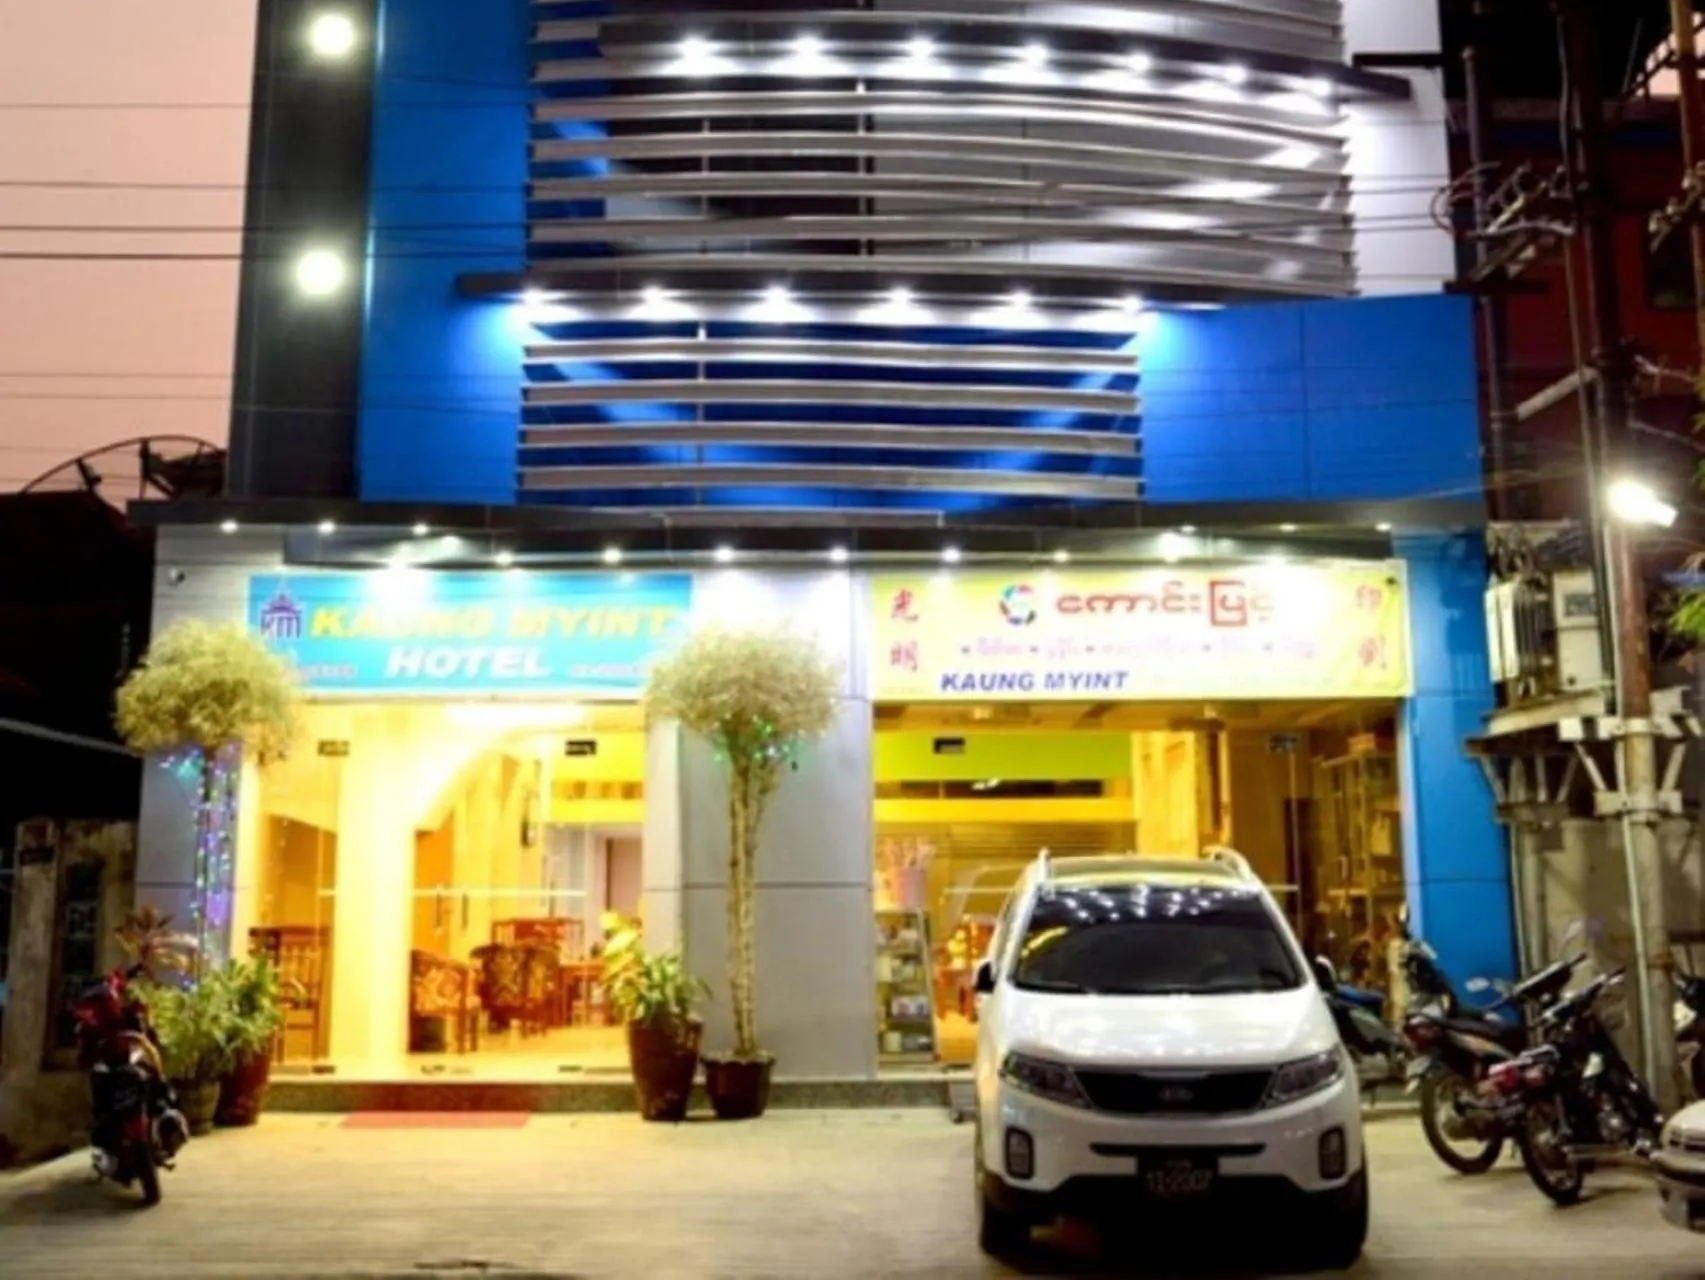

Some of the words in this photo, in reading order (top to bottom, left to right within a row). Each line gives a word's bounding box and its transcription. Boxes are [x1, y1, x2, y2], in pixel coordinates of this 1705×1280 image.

[311, 606, 492, 637] KAUNG
[509, 606, 674, 637] MYINT
[387, 646, 549, 677] HOTEL
[941, 671, 1036, 692] KAUNG
[1044, 670, 1129, 691] MYINT
